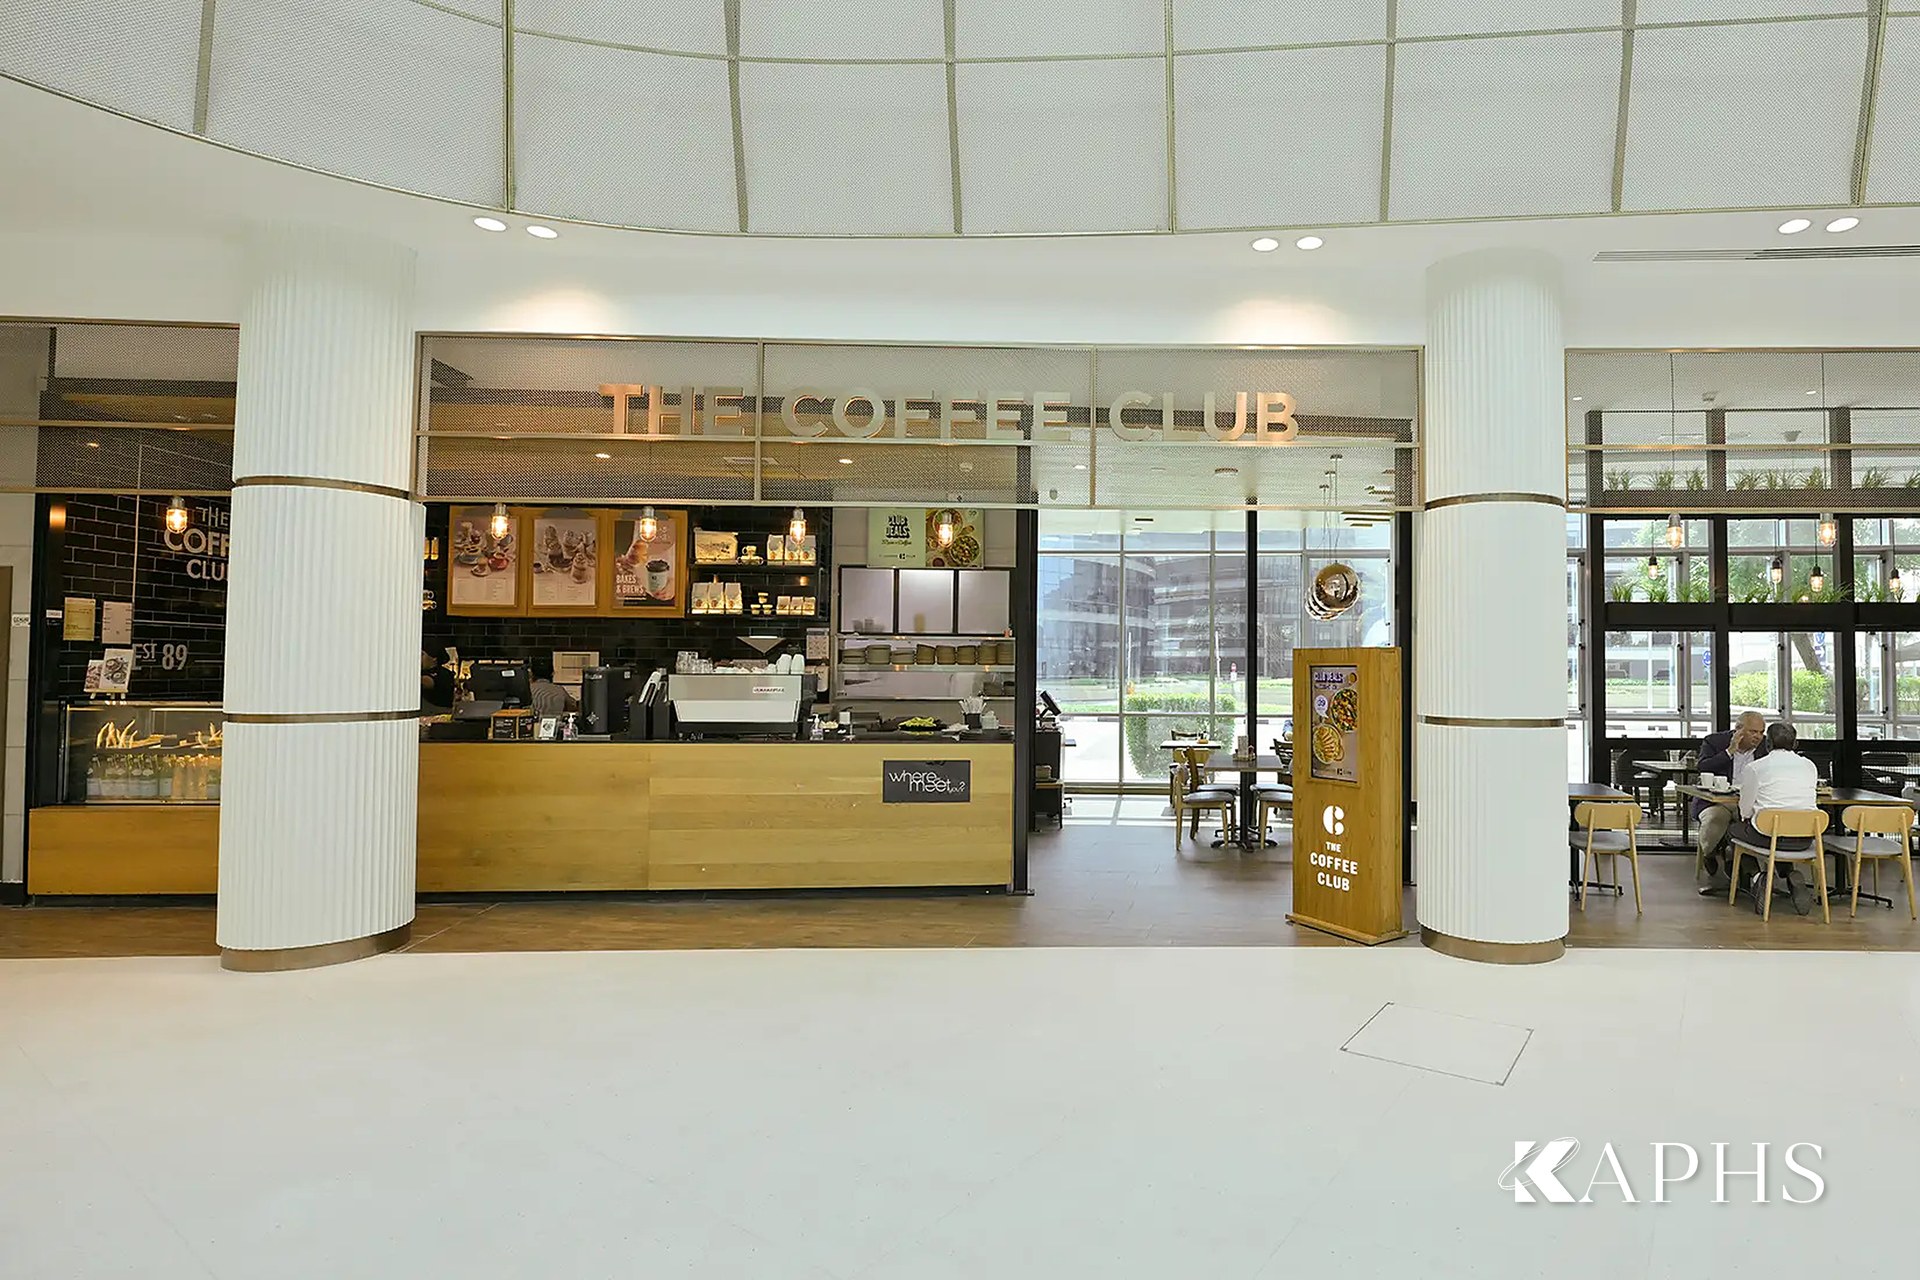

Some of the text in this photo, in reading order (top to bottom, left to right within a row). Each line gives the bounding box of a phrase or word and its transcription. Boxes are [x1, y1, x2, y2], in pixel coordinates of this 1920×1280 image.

[600, 384, 1300, 442] THE COFFEE CLUB
[196, 507, 229, 527] THE
[164, 528, 230, 557] COFF
[186, 559, 228, 581] CLU
[616, 574, 636, 584] BAKES
[162, 644, 188, 670] 89
[888, 770, 940, 784] where
[908, 778, 951, 793] meet
[1326, 842, 1342, 853] THE
[1310, 852, 1358, 875] COFFEE
[1317, 872, 1350, 892] CLUB
